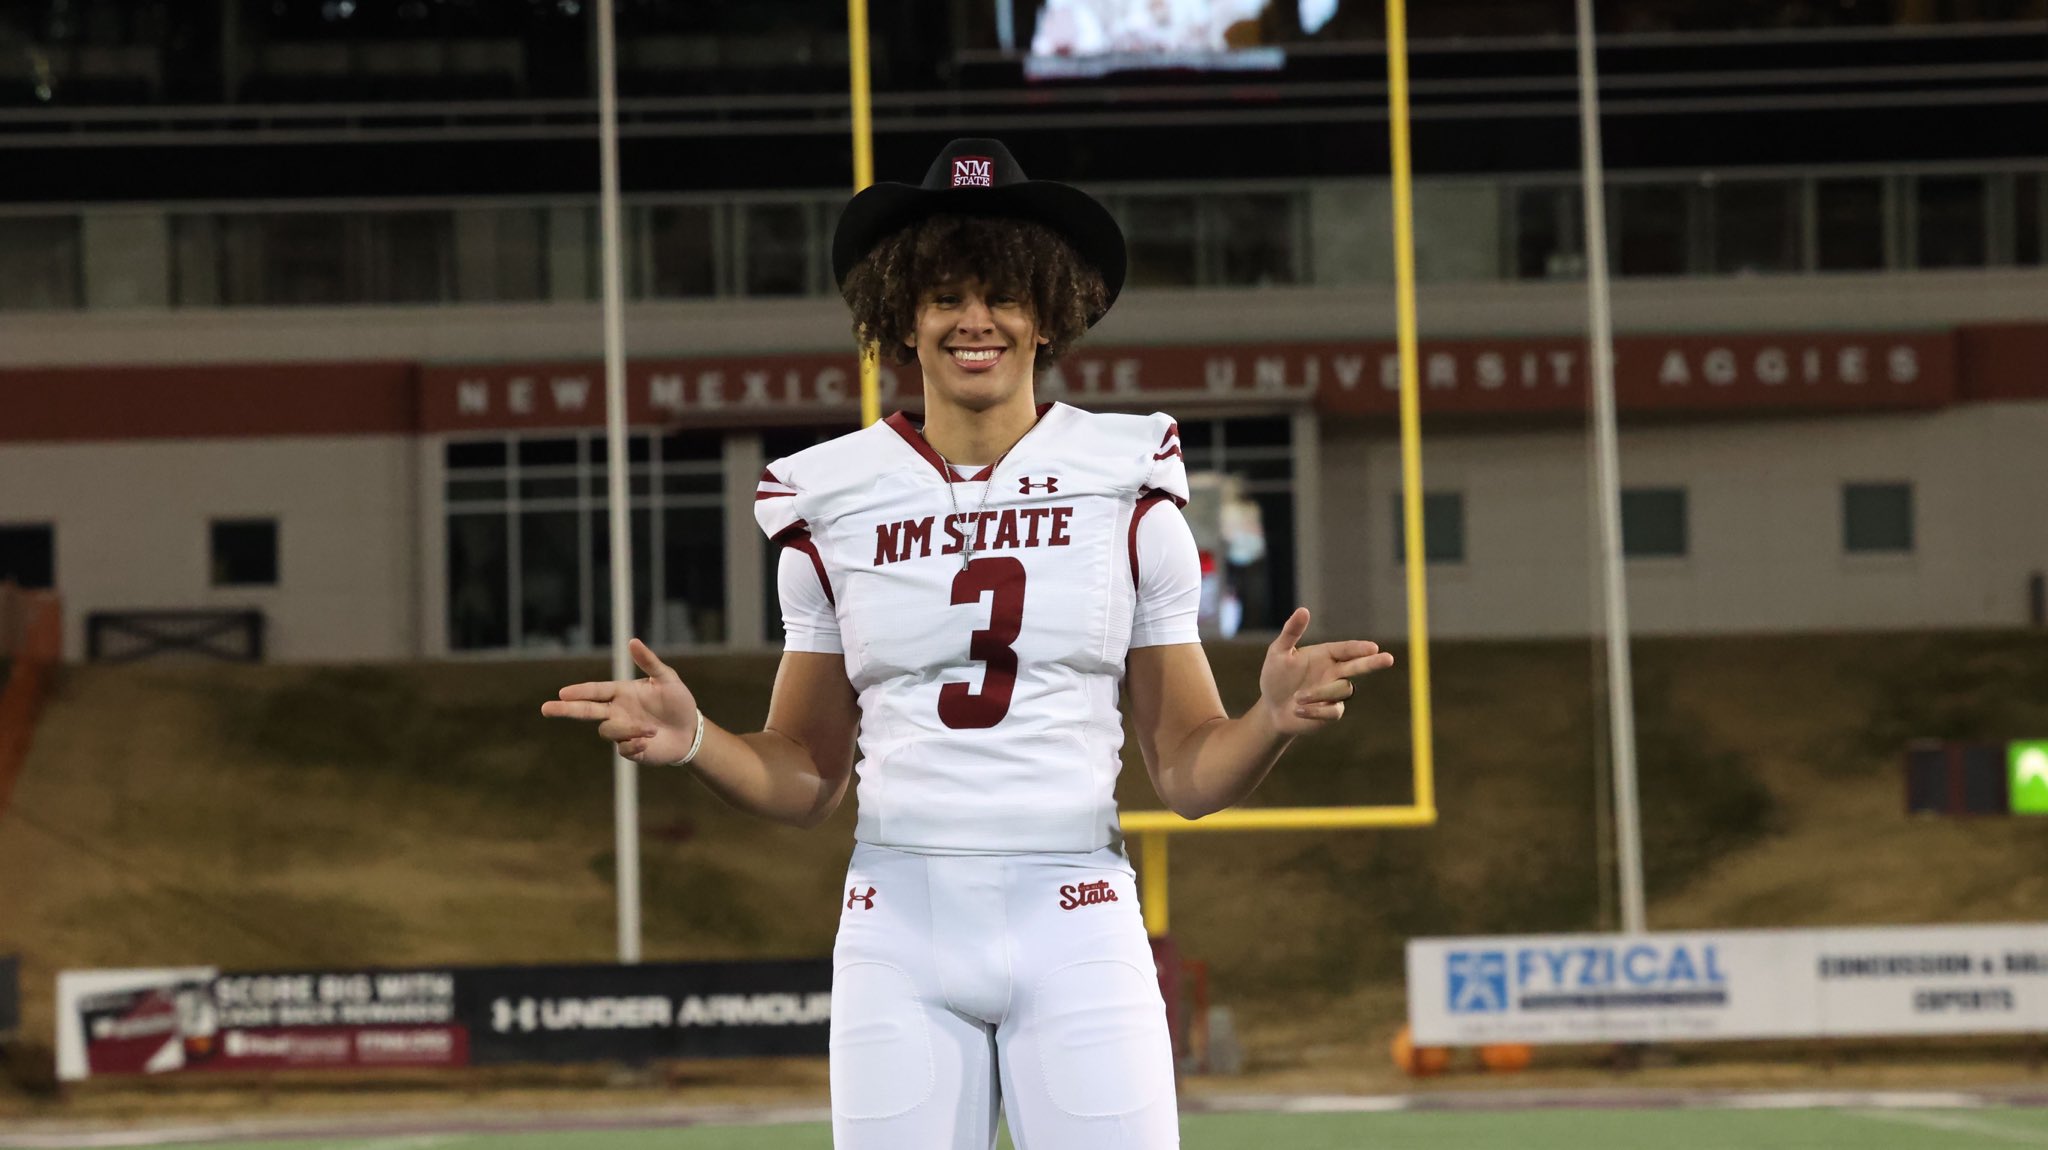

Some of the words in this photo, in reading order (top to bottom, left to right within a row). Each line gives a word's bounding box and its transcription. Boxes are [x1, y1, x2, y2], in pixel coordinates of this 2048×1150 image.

[953, 177, 990, 187] STATE
[954, 160, 991, 177] NM
[457, 377, 591, 414] NEW
[1038, 358, 1141, 393] ATE
[1205, 349, 1619, 393] UNIVERSIT
[1658, 346, 1920, 385] AGGIES
[874, 515, 935, 567] NM
[941, 507, 1074, 555] STATE
[937, 556, 1027, 730] 3
[1060, 880, 1119, 910] State
[1516, 944, 1726, 985] FYZICAL
[216, 976, 312, 1005] SCORE
[318, 974, 371, 1002] BIG
[376, 972, 453, 999] WITH
[541, 996, 672, 1029] UNDER
